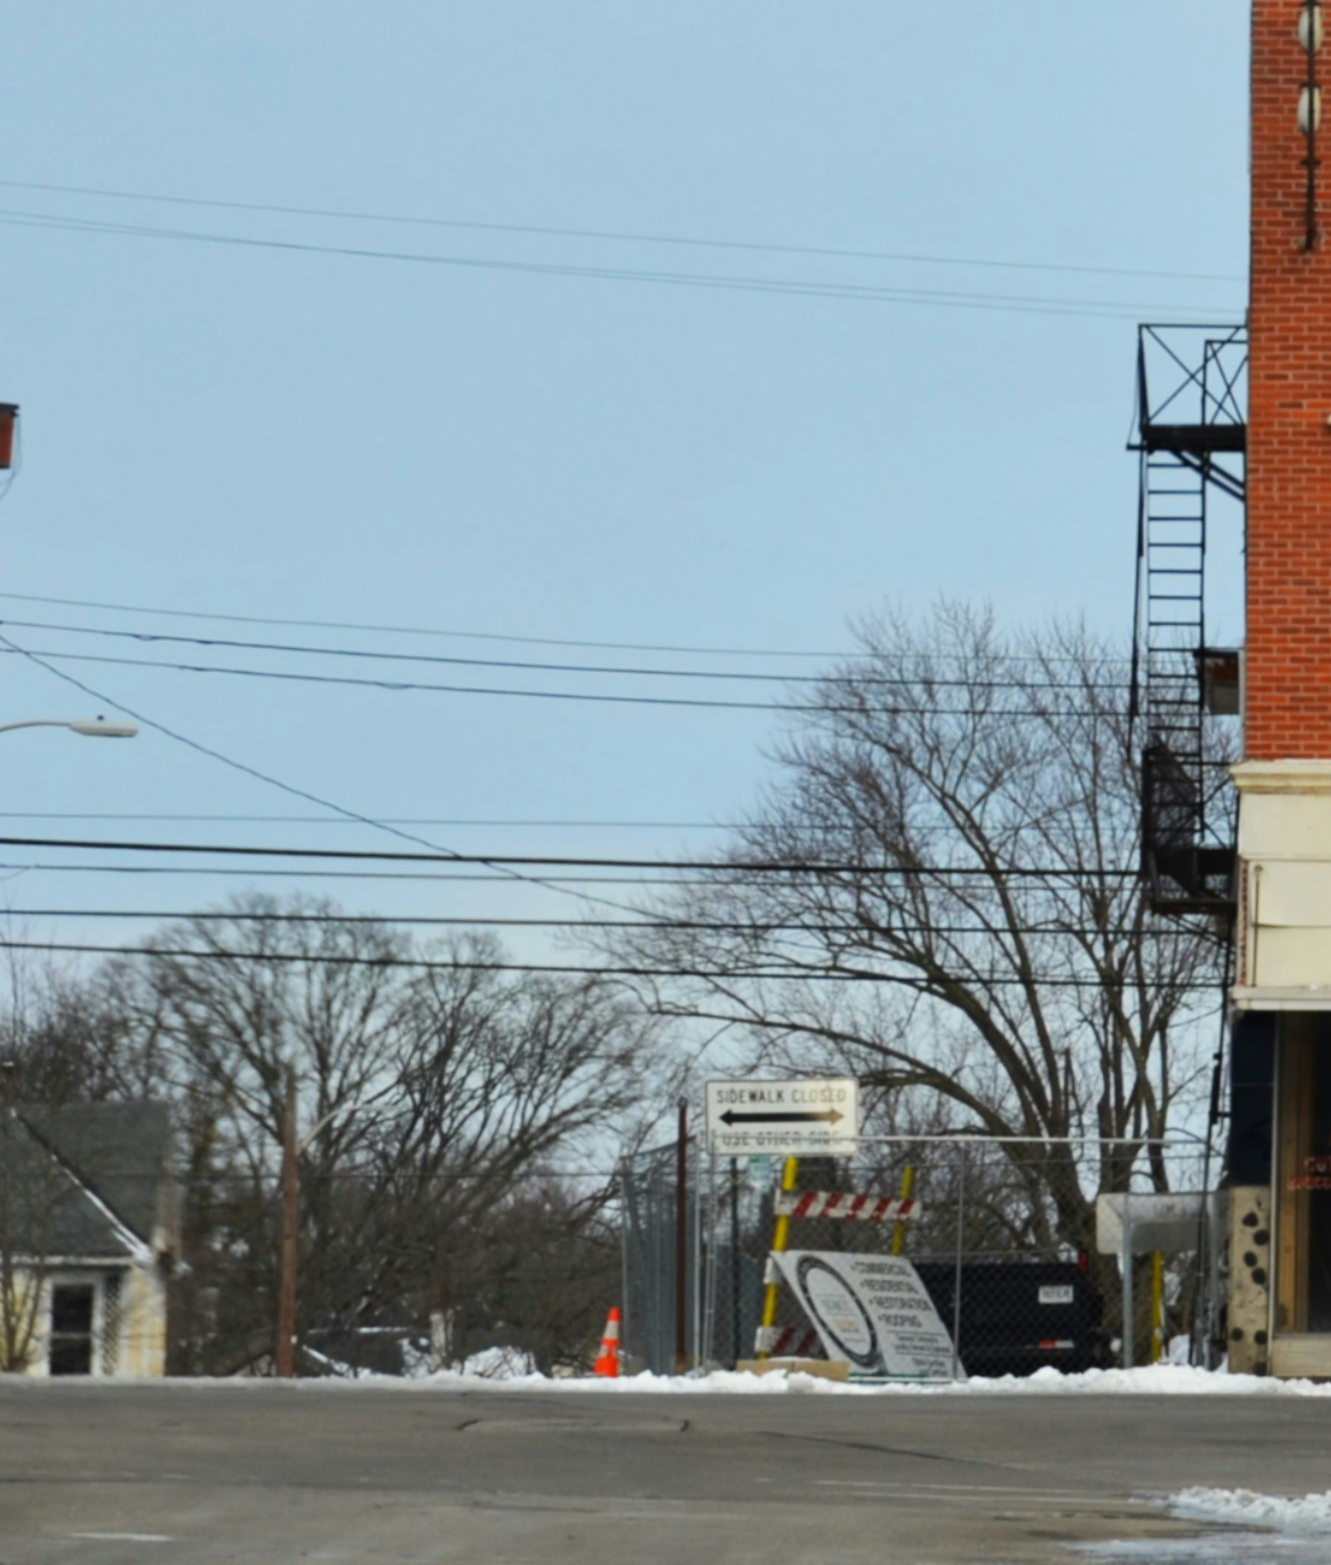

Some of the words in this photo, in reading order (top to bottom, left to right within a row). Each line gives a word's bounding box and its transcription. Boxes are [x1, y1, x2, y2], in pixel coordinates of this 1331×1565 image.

[716, 1088, 785, 1104] SIDEWALK
[791, 1088, 847, 1104] CLOSED
[722, 1131, 750, 1146] USE
